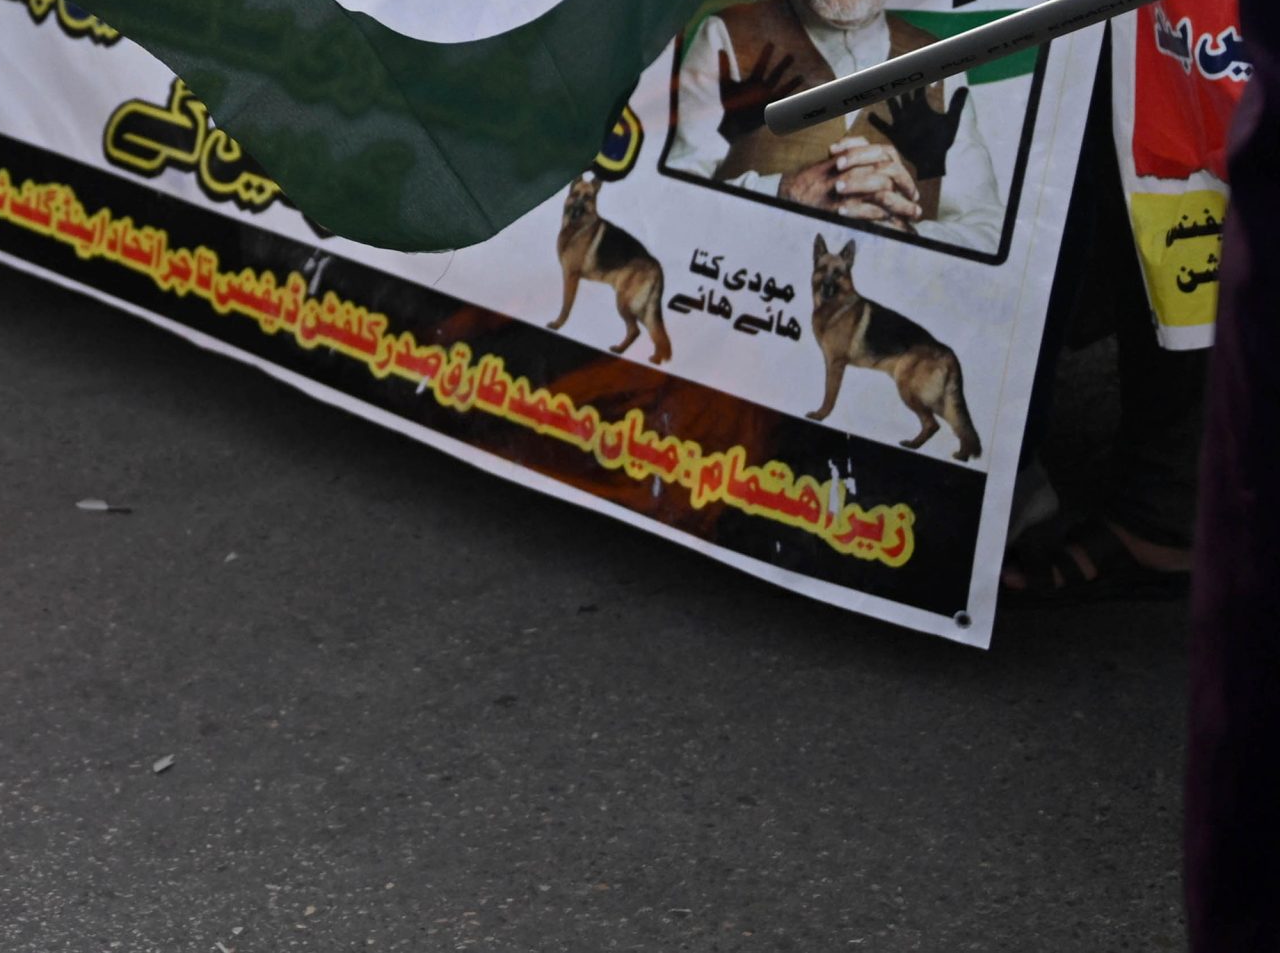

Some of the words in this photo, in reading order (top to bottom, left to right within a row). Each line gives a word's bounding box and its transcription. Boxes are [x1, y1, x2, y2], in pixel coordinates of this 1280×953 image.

[842, 70, 925, 107] METRO
[105, 216, 170, 276] اتحاد
[154, 246, 219, 298] تاجر
[688, 246, 726, 277] کتا
[210, 268, 307, 335] ڈیفنس
[721, 265, 796, 305] مودی
[294, 291, 391, 364] کلفٹن
[369, 331, 447, 388] صدر
[433, 342, 515, 412] طارق
[505, 376, 600, 452] محمد
[594, 409, 681, 482] میاں
[833, 503, 916, 567] زیر
